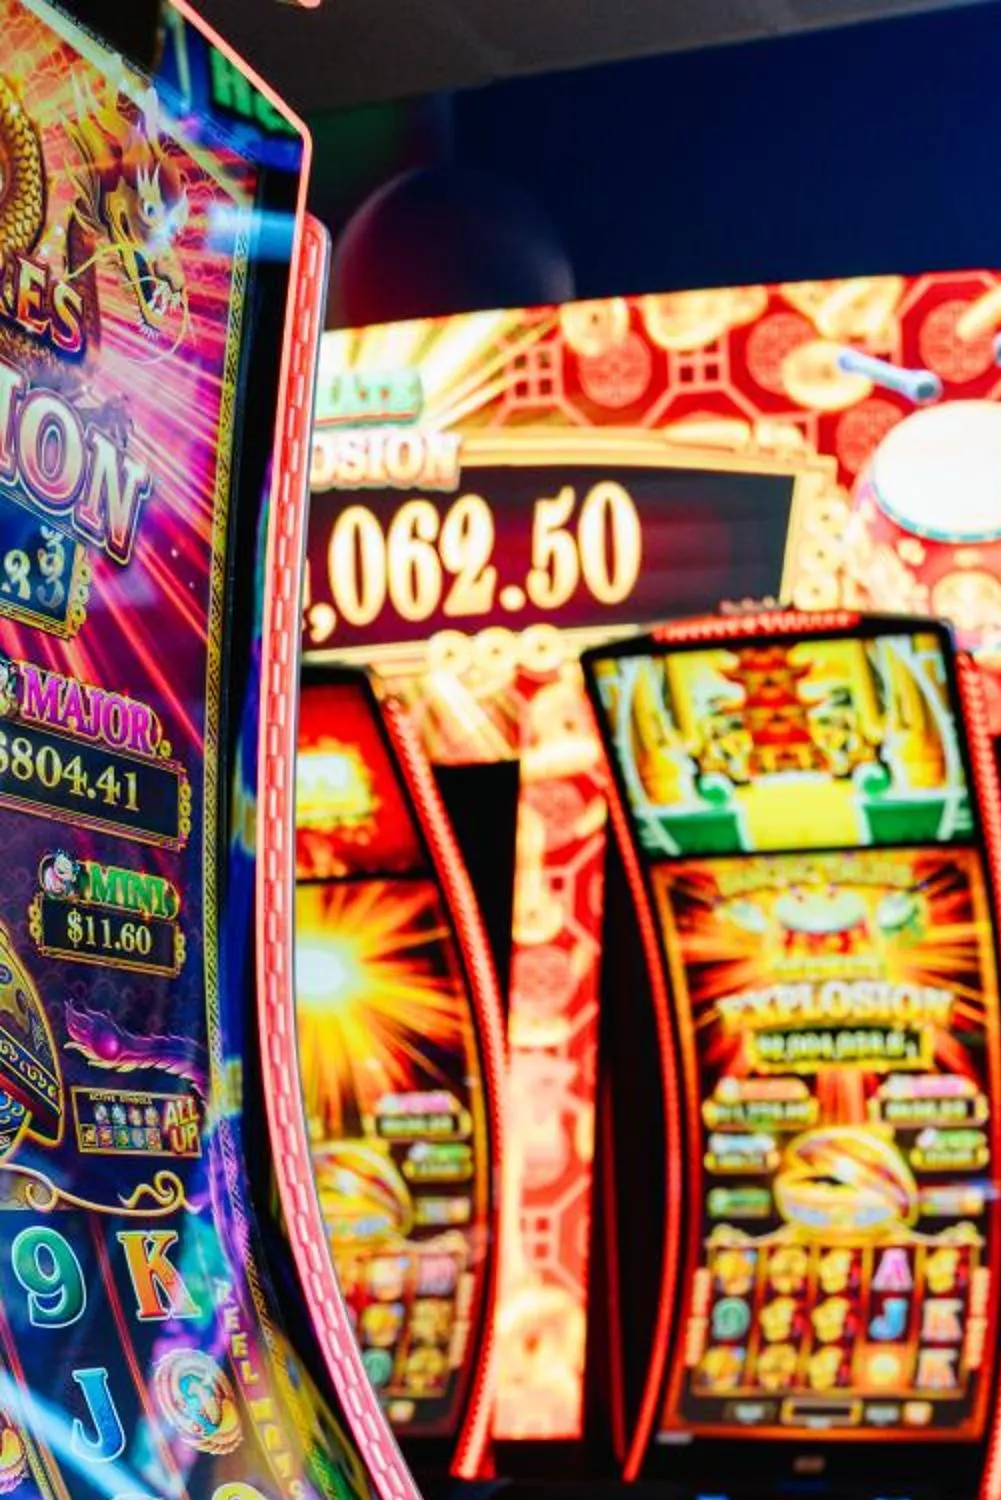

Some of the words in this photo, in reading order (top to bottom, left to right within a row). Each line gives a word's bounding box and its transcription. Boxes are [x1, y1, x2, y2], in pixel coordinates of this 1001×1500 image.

[0, 255, 82, 353] ES
[302, 480, 641, 643] ,062.50
[23, 664, 156, 757] MAJOR
[67, 908, 151, 955] $11.60
[165, 1095, 199, 1128] ALL
[12, 1225, 86, 1328] 9
[117, 1230, 201, 1322] K
[71, 1368, 126, 1462] J
